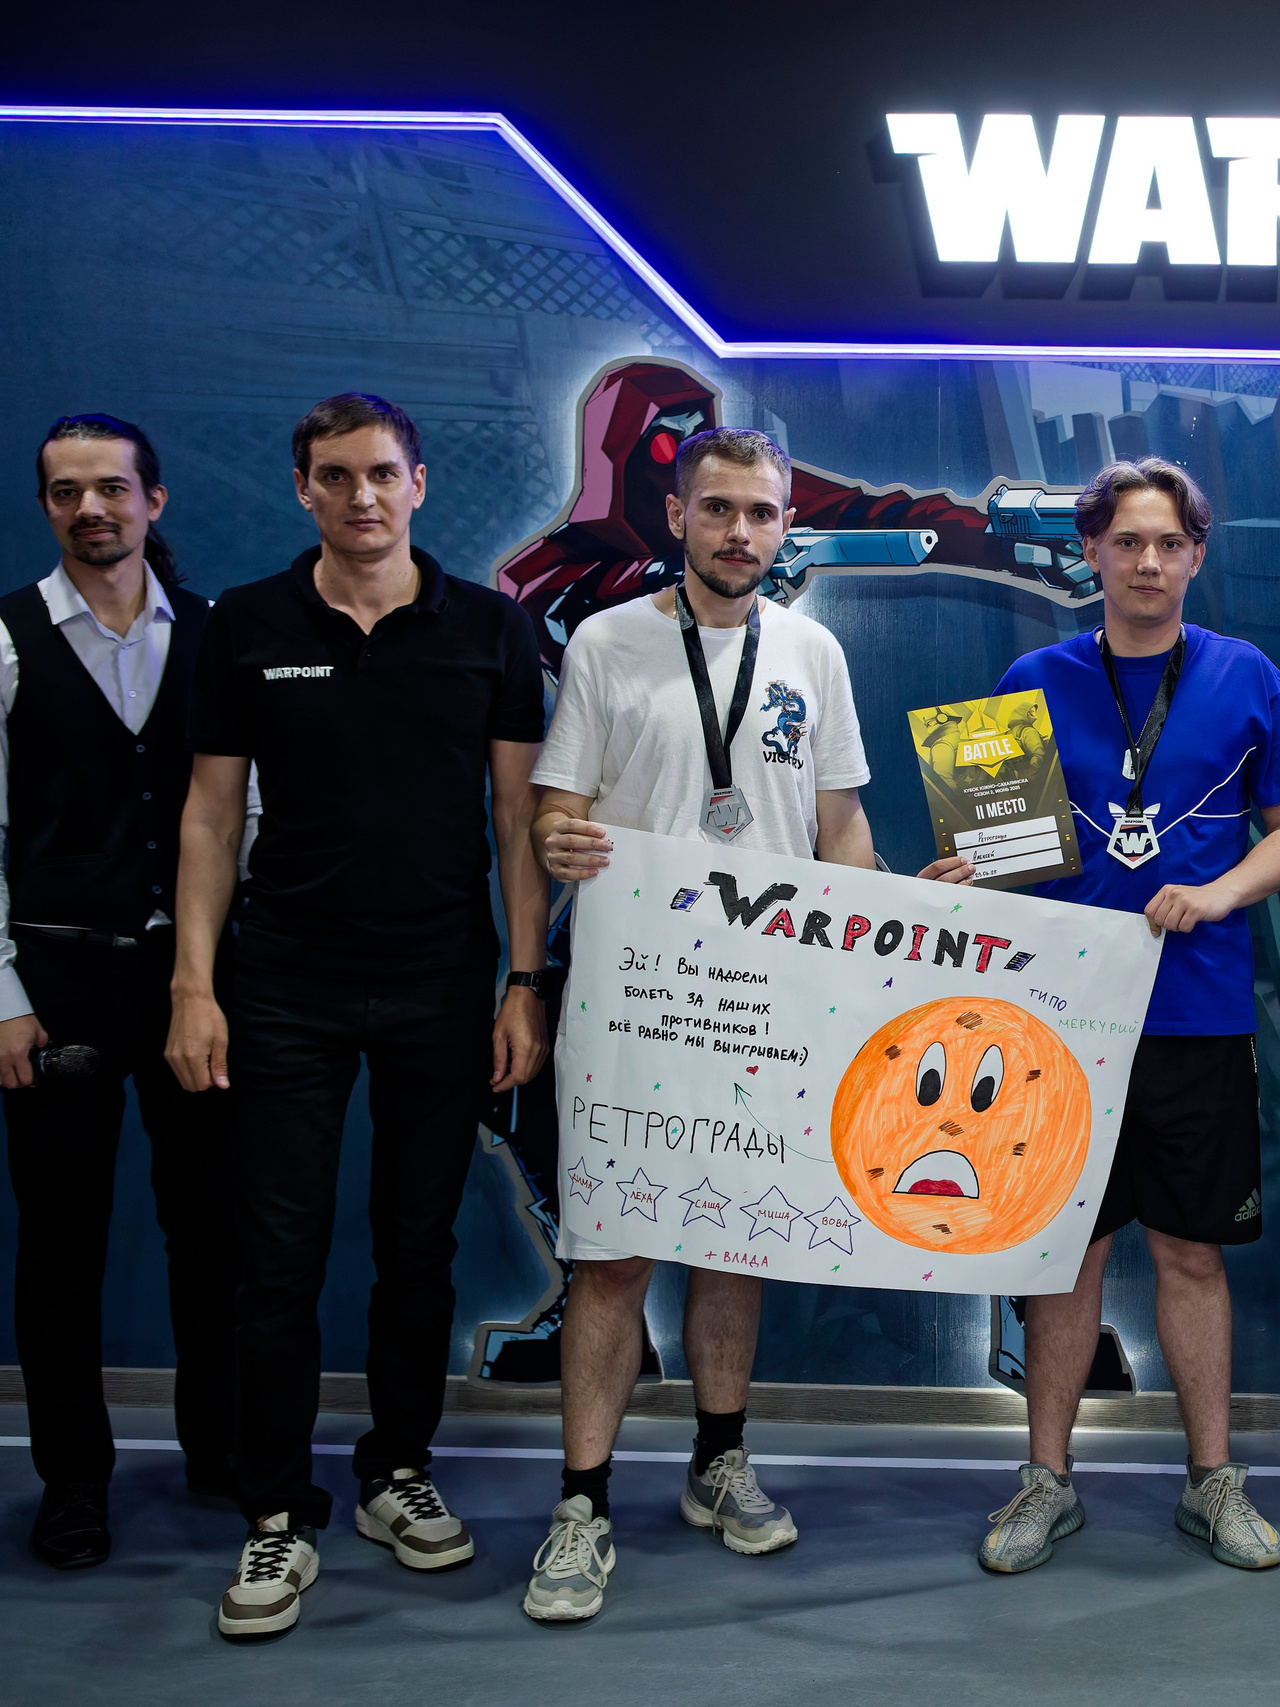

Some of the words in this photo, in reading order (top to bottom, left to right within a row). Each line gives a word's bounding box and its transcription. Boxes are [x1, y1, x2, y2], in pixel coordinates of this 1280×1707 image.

[263, 666, 334, 681] WARPOINT
[963, 738, 1014, 762] BATTLE
[985, 797, 1027, 819] МЕСТО
[704, 871, 1012, 973] WARPOINT
[677, 957, 699, 976] Вы
[624, 985, 674, 1000] БОЛЕТЬ
[686, 992, 704, 1008] ЗА
[718, 998, 771, 1015] НАШИХ
[1029, 988, 1067, 1012] ТИПО
[608, 1019, 632, 1033] ВСЁ
[638, 1025, 679, 1042] РАВНО
[684, 1034, 705, 1048] МЫ
[1058, 1018, 1139, 1034] МЕРКУРИЙ
[573, 1096, 785, 1163] РЕТРОГРАДЫ
[571, 1172, 594, 1190] ДИМА
[629, 1187, 653, 1204] ЛЁХА
[694, 1199, 721, 1211] САША
[757, 1208, 791, 1220] МИША
[821, 1216, 849, 1229] ВОВА
[723, 1251, 769, 1268] ВЛАДА
